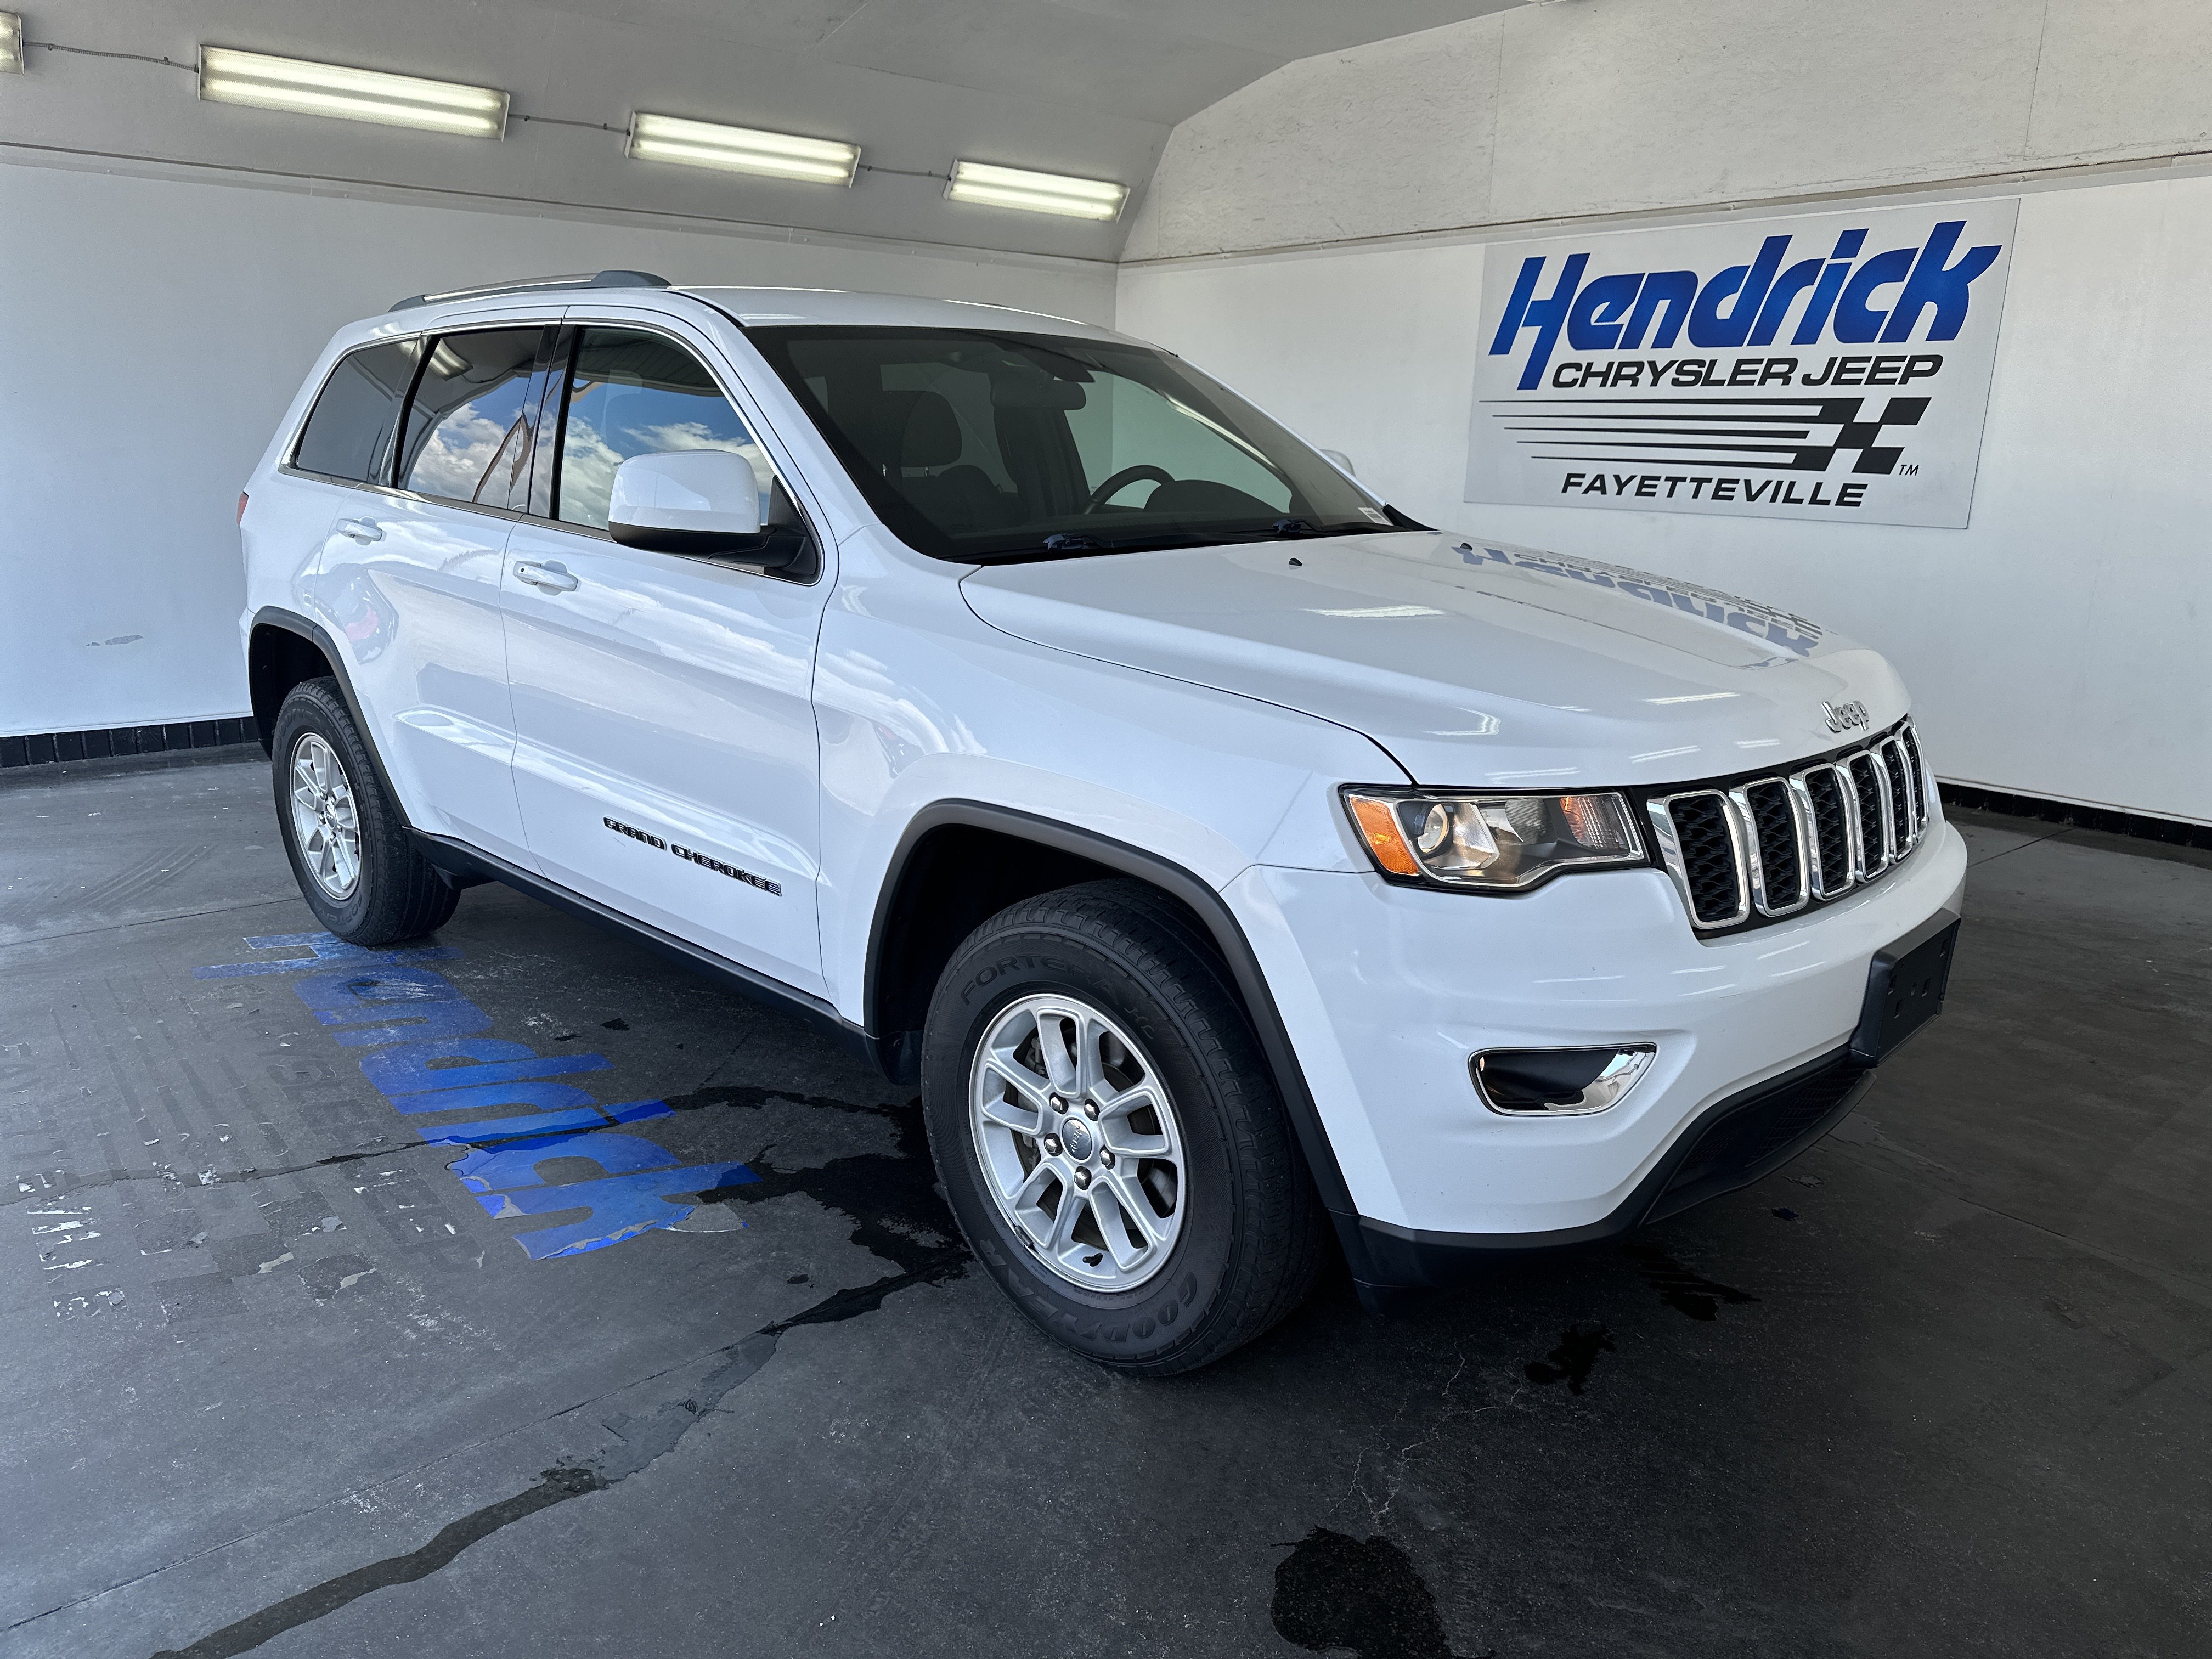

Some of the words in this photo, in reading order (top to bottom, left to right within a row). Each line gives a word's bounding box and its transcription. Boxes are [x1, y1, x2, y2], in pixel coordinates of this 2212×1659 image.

[1489, 221, 2001, 390] Hendrick
[1552, 358, 1798, 388] CHRYSLER
[1801, 354, 1944, 386] JEEP
[1899, 464, 1919, 476] TM
[1561, 473, 1869, 507] FAYETTEVILLE
[1821, 700, 1870, 733] Jeep
[603, 816, 667, 851] GRAND
[671, 842, 782, 897] CHEROKEE
[979, 1238, 1197, 1343] GOODYEAR
